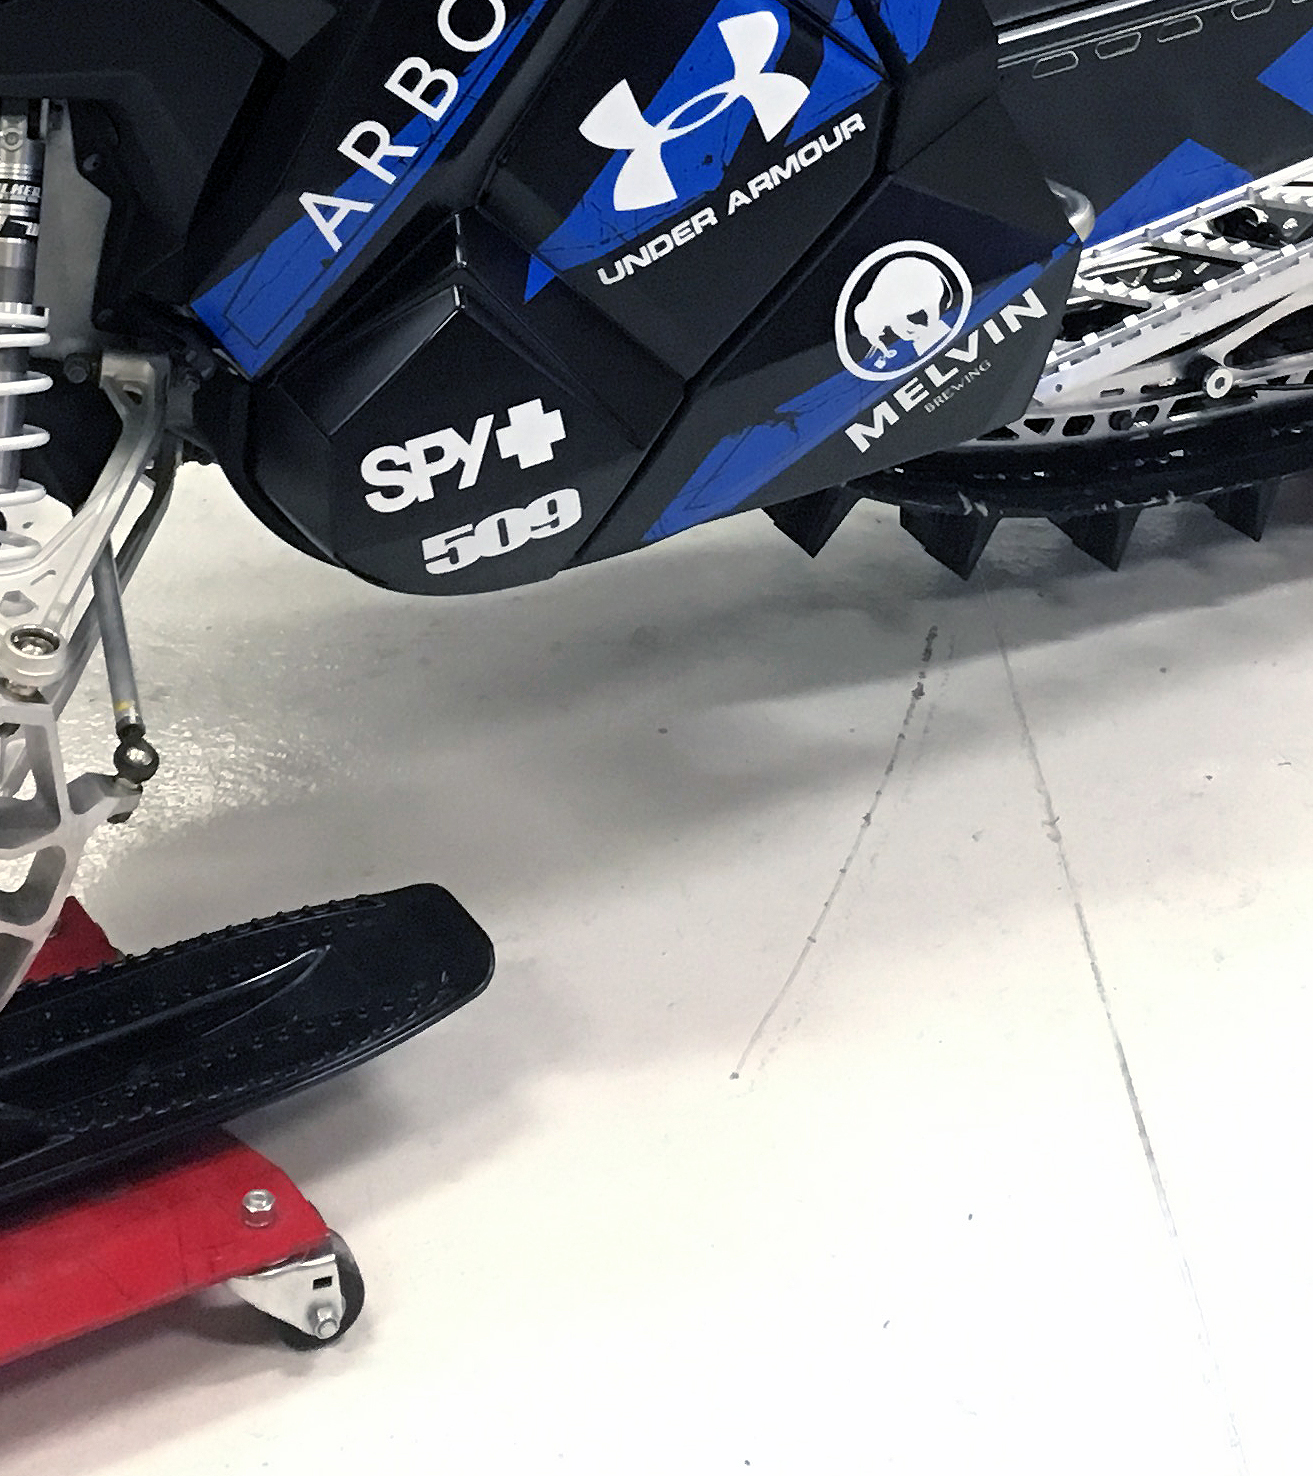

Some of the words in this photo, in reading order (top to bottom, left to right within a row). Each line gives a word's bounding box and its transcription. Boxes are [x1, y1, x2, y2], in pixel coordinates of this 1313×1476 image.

[597, 207, 718, 285] UNDER
[727, 112, 867, 216] ARMOUR
[845, 287, 1048, 453] MELVIN
[923, 358, 992, 414] BREWING
[421, 487, 582, 575] 509
